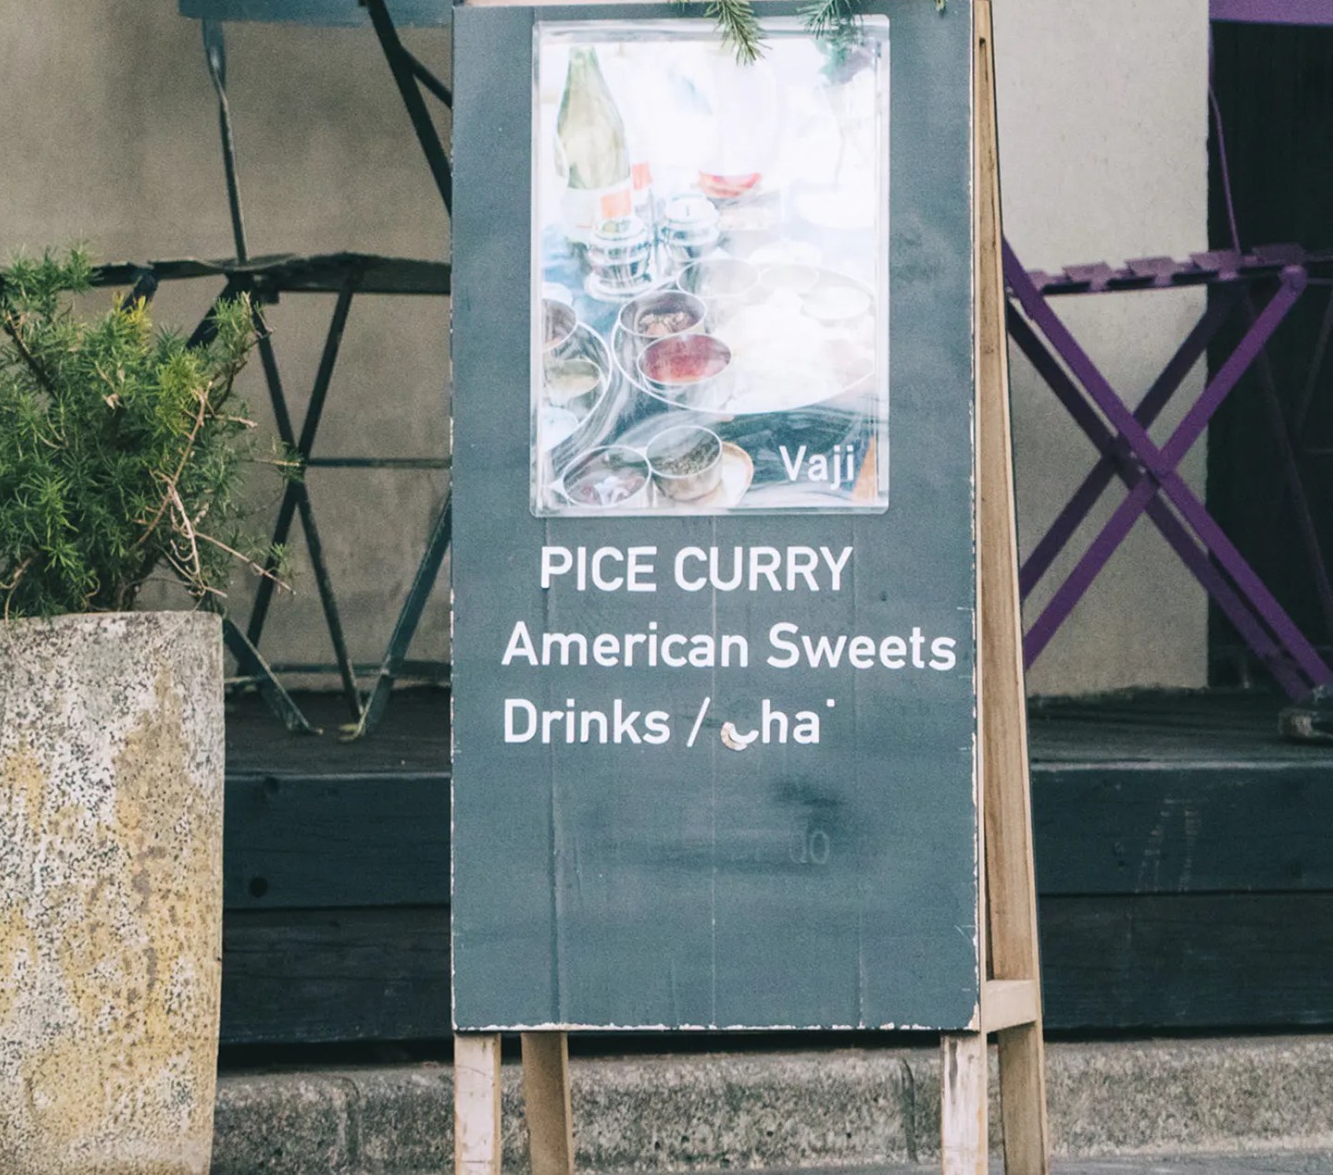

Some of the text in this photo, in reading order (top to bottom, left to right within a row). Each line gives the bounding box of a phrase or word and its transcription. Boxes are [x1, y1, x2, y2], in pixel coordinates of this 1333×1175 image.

[779, 445, 855, 490] Vaji
[540, 546, 853, 592] PICE CURRY
[502, 621, 957, 670] American Sweets
[504, 698, 671, 744] Drinks
